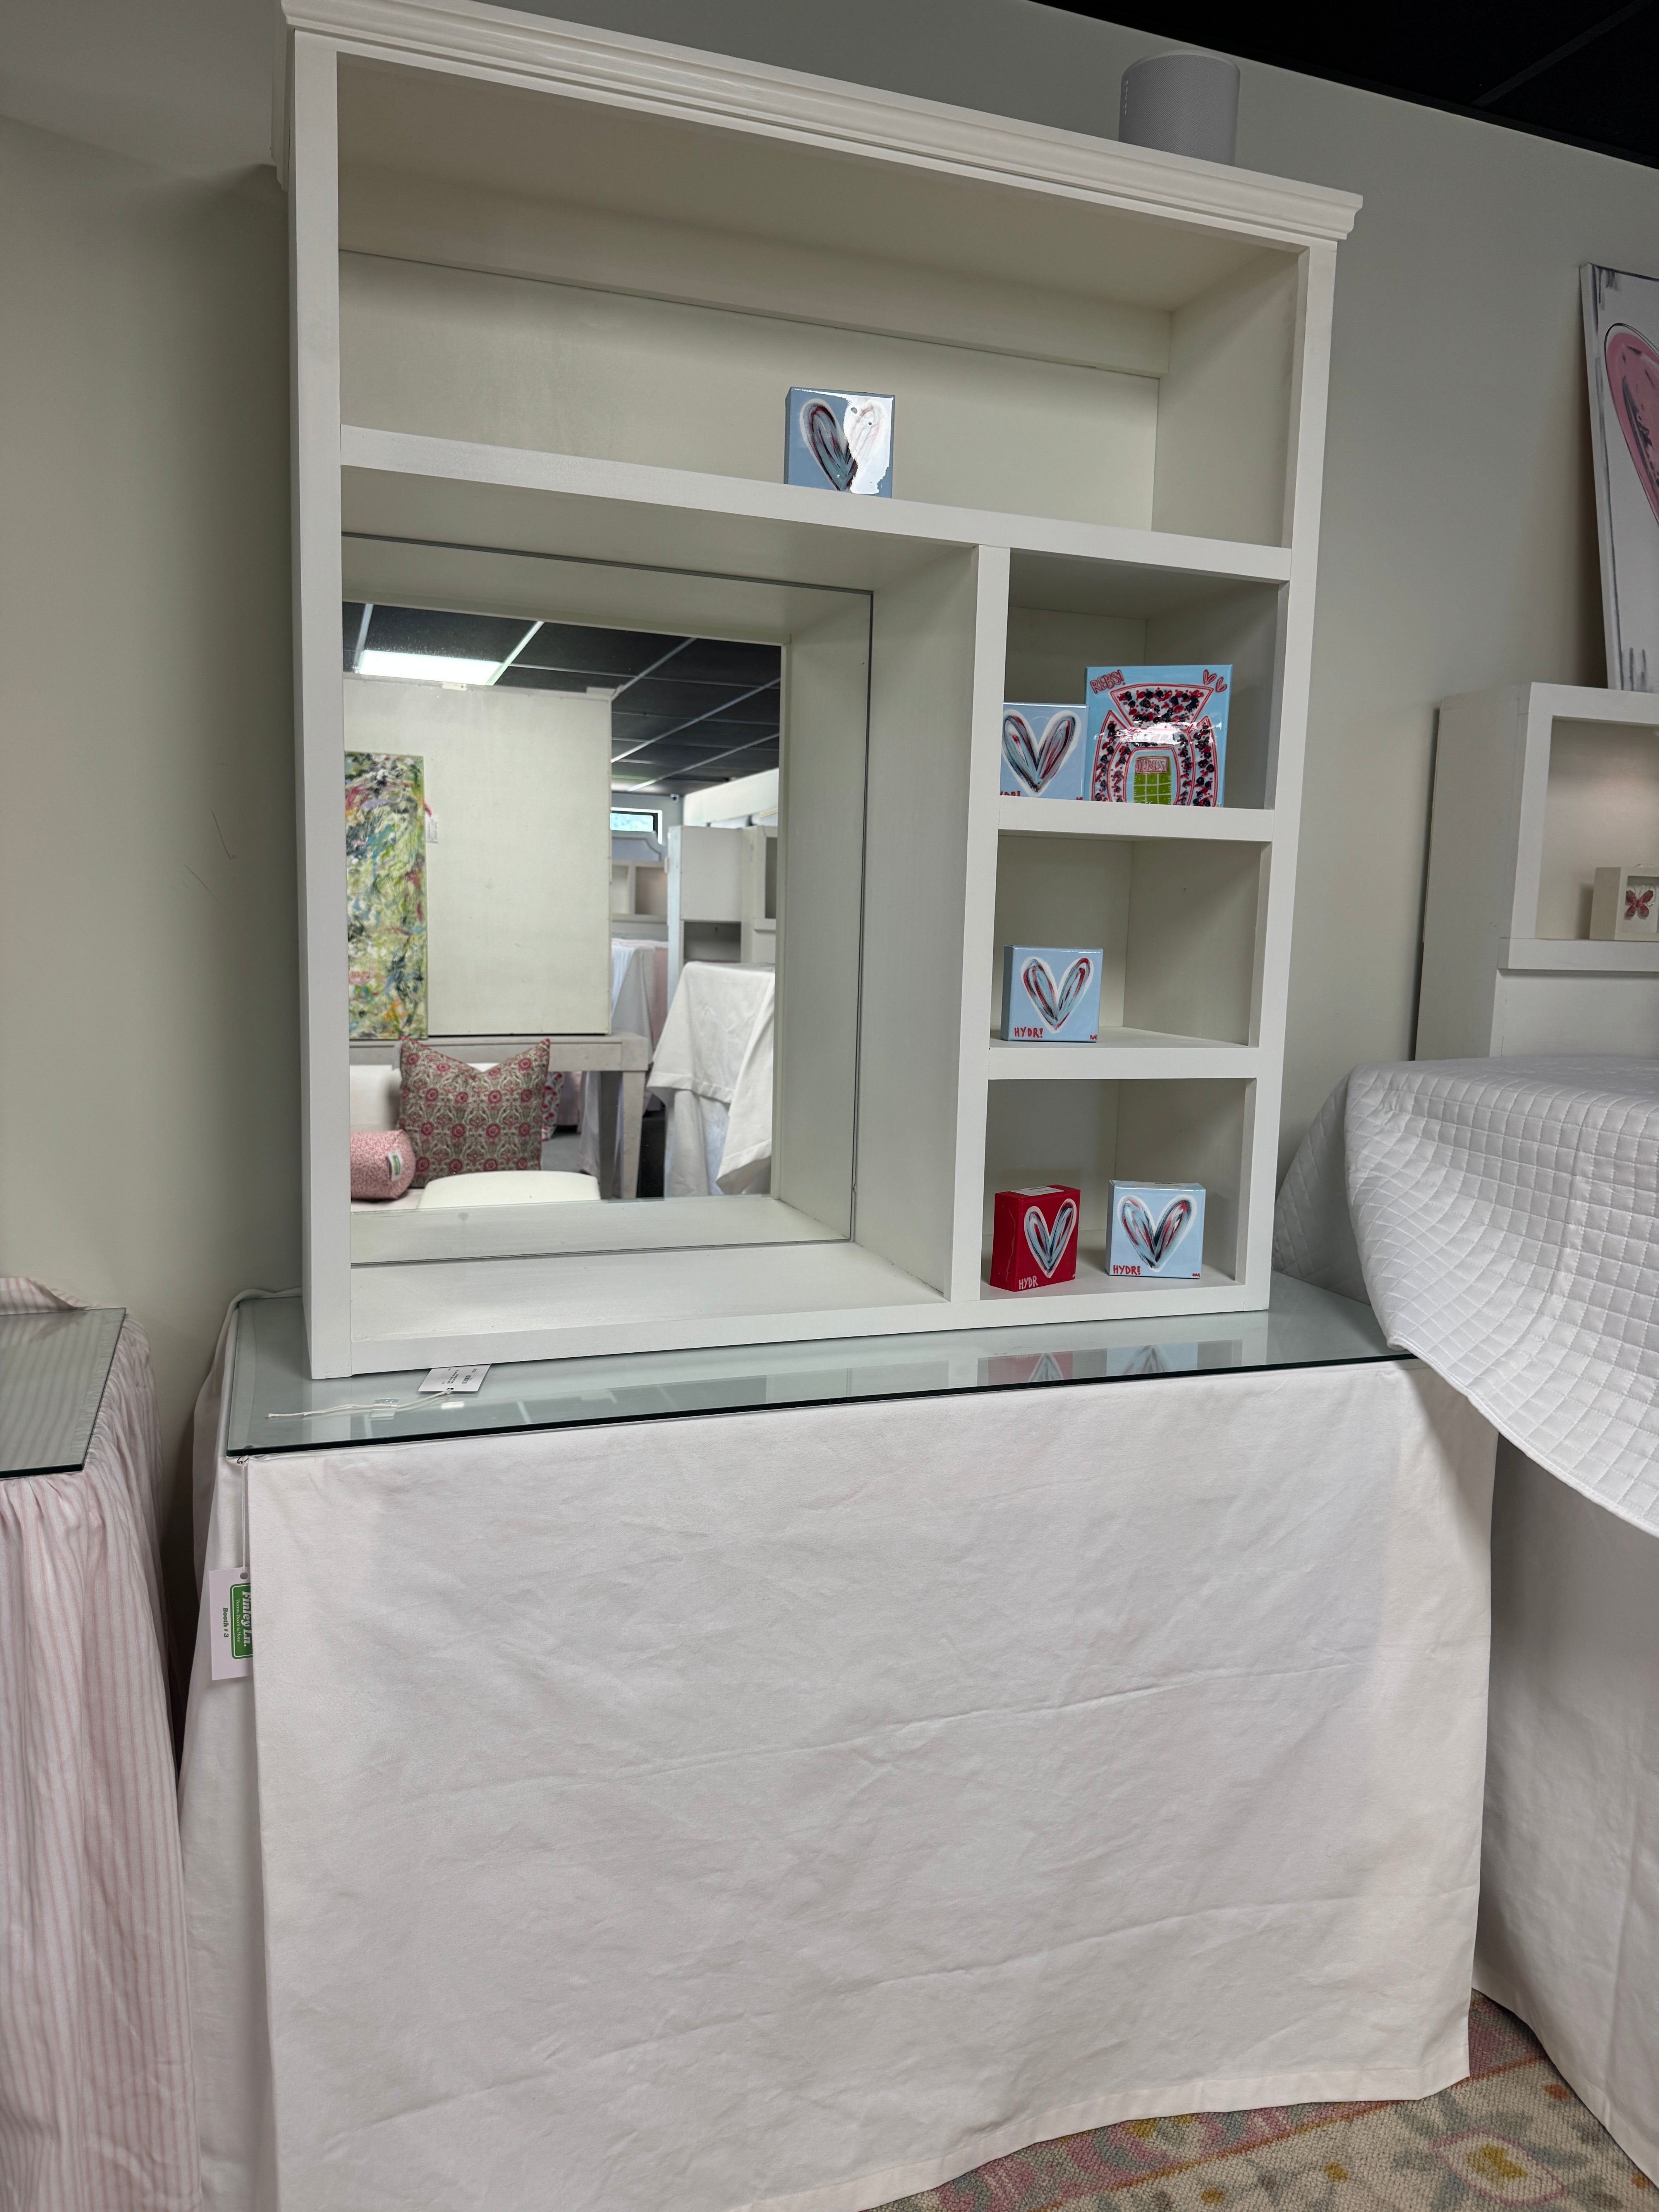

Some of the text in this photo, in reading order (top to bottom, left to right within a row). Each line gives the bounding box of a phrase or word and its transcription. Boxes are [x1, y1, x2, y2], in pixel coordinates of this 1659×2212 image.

[1090, 669, 1126, 694] REBS!
[1014, 1027, 1043, 1038] HYDR!
[1113, 1265, 1140, 1275] HYDR!
[1018, 1275, 1038, 1290] HYDR
[241, 1591, 252, 1647] Finley Ln.
